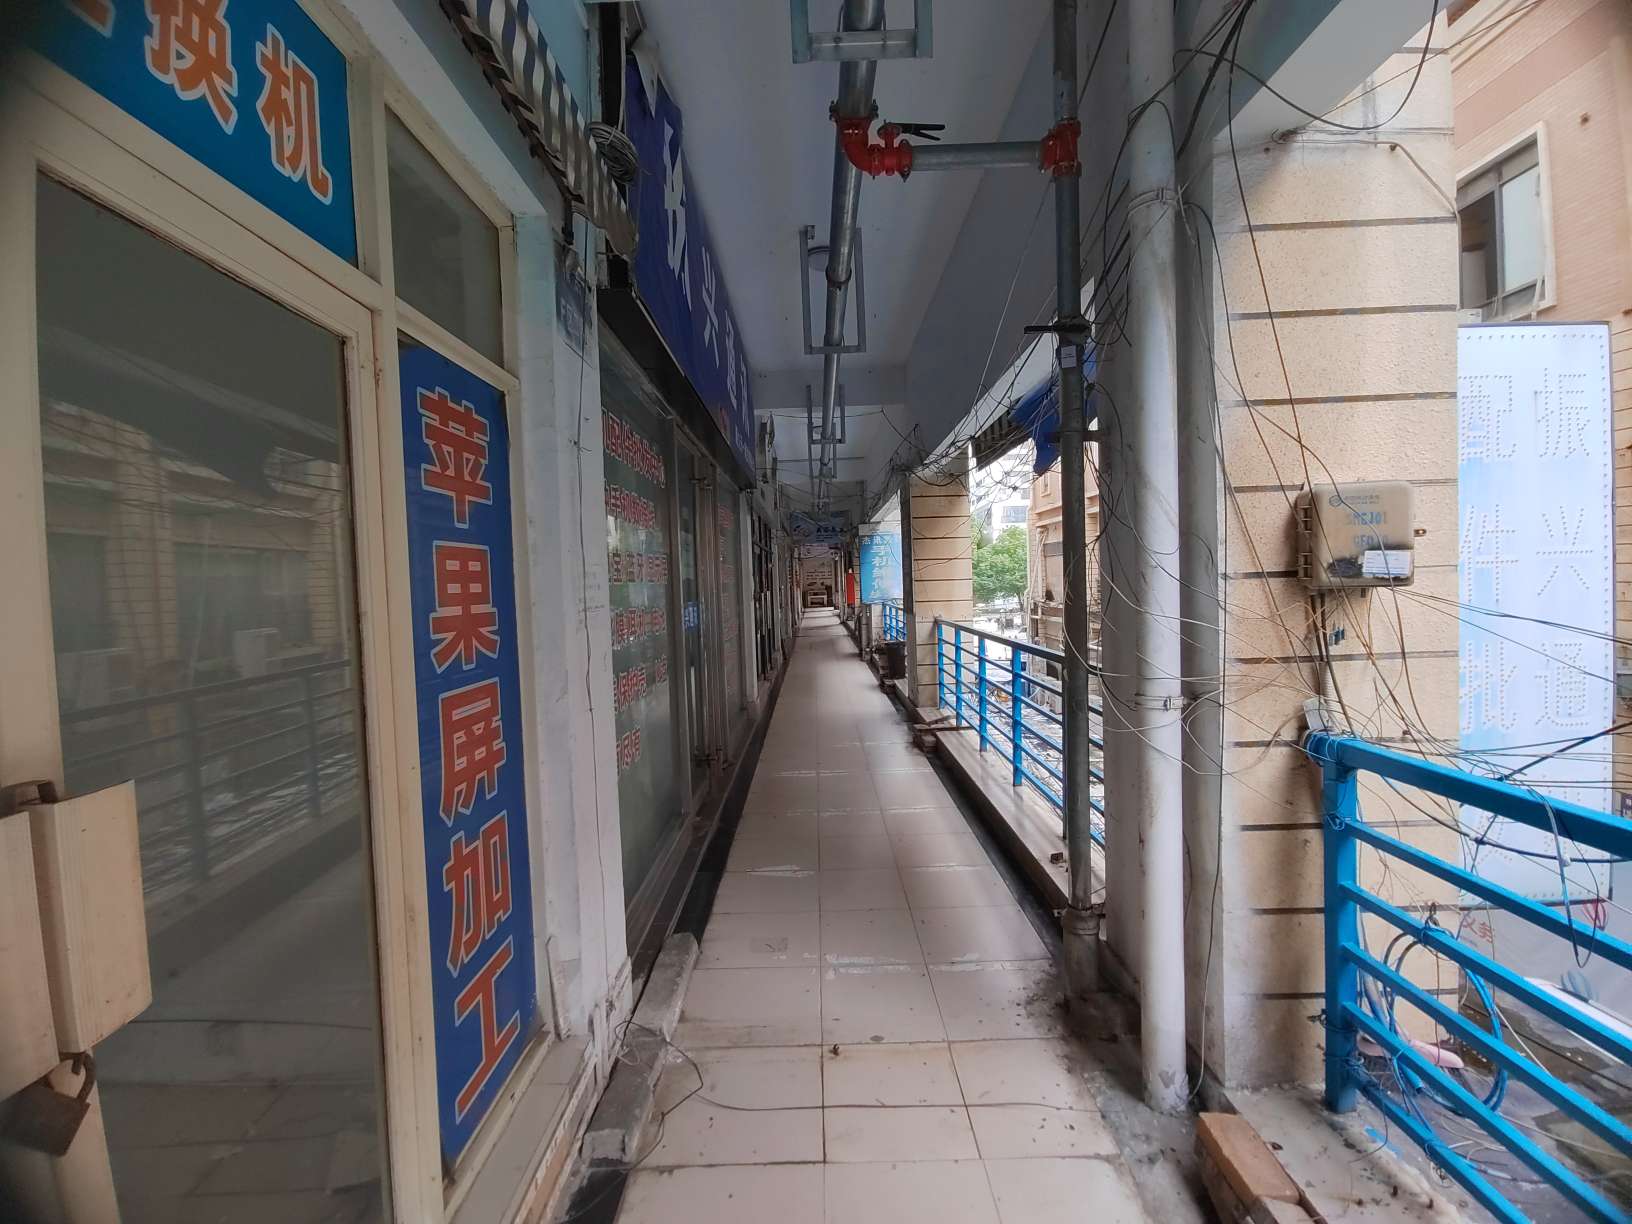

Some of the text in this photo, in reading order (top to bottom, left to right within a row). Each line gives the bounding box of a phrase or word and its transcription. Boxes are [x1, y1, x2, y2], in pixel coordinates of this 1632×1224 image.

[64, 0, 333, 205] 换机
[416, 387, 523, 1126] 苹果屏加工
